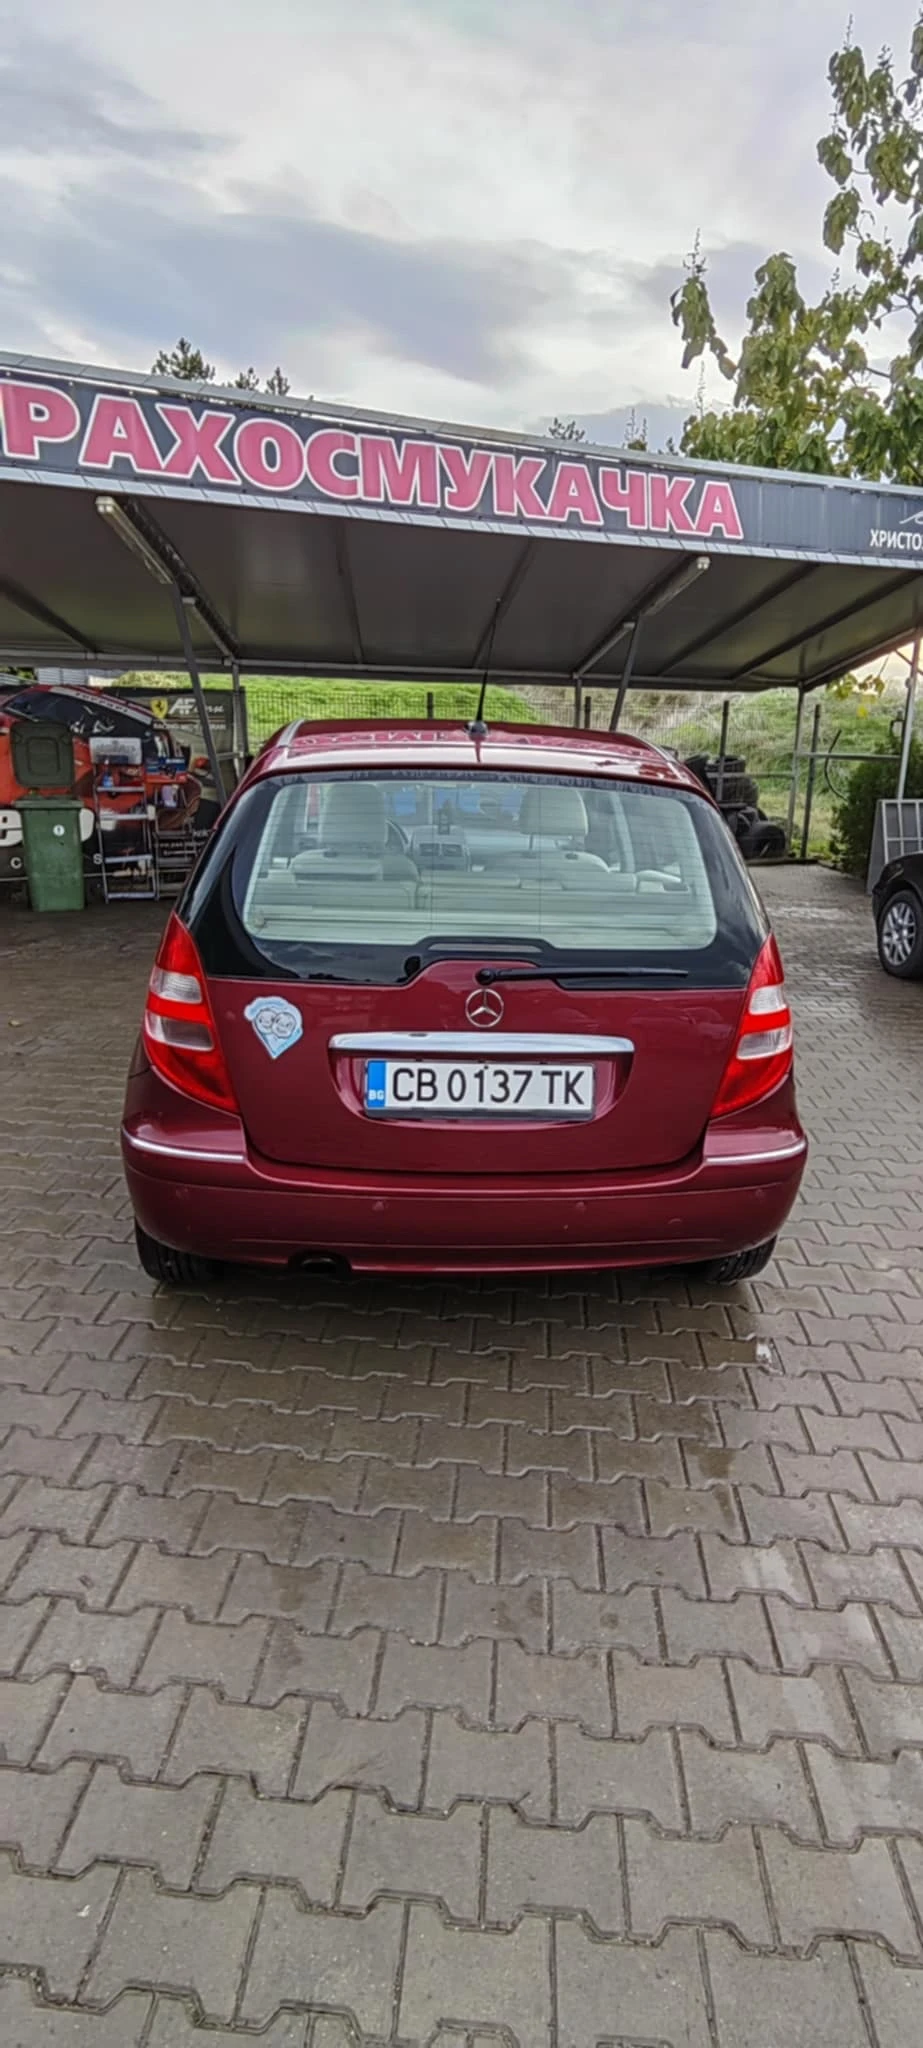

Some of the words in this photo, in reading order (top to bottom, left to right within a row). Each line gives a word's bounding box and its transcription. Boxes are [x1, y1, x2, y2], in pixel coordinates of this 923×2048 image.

[0, 379, 744, 540] РАХОСМУКАЧКА
[368, 1090, 384, 1100] BG
[393, 1068, 438, 1102] CB
[447, 1069, 533, 1103] 0137
[541, 1071, 585, 1105] TK
